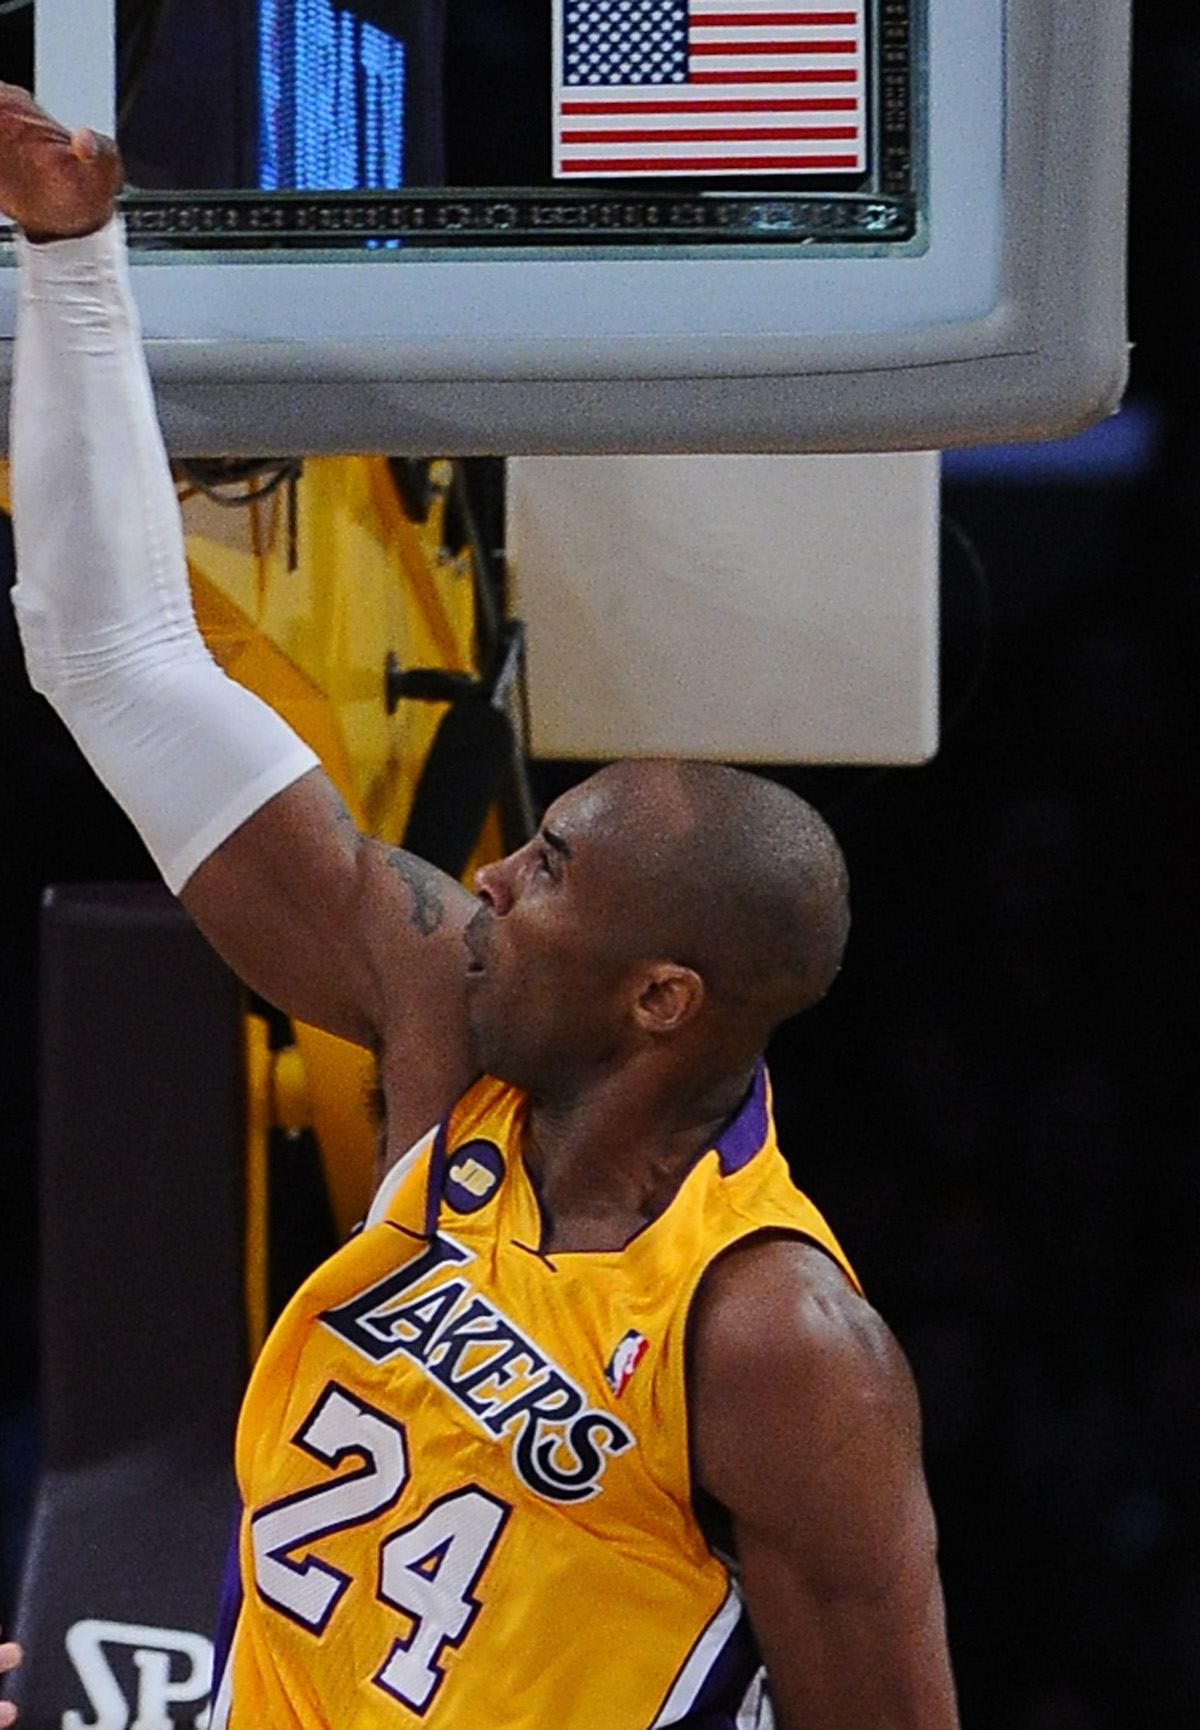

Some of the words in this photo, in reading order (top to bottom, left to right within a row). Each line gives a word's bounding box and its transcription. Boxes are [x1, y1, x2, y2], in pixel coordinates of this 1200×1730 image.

[318, 1229, 637, 1504] LAKERS
[61, 1618, 215, 1730] SP
[249, 1379, 513, 1718] 24
